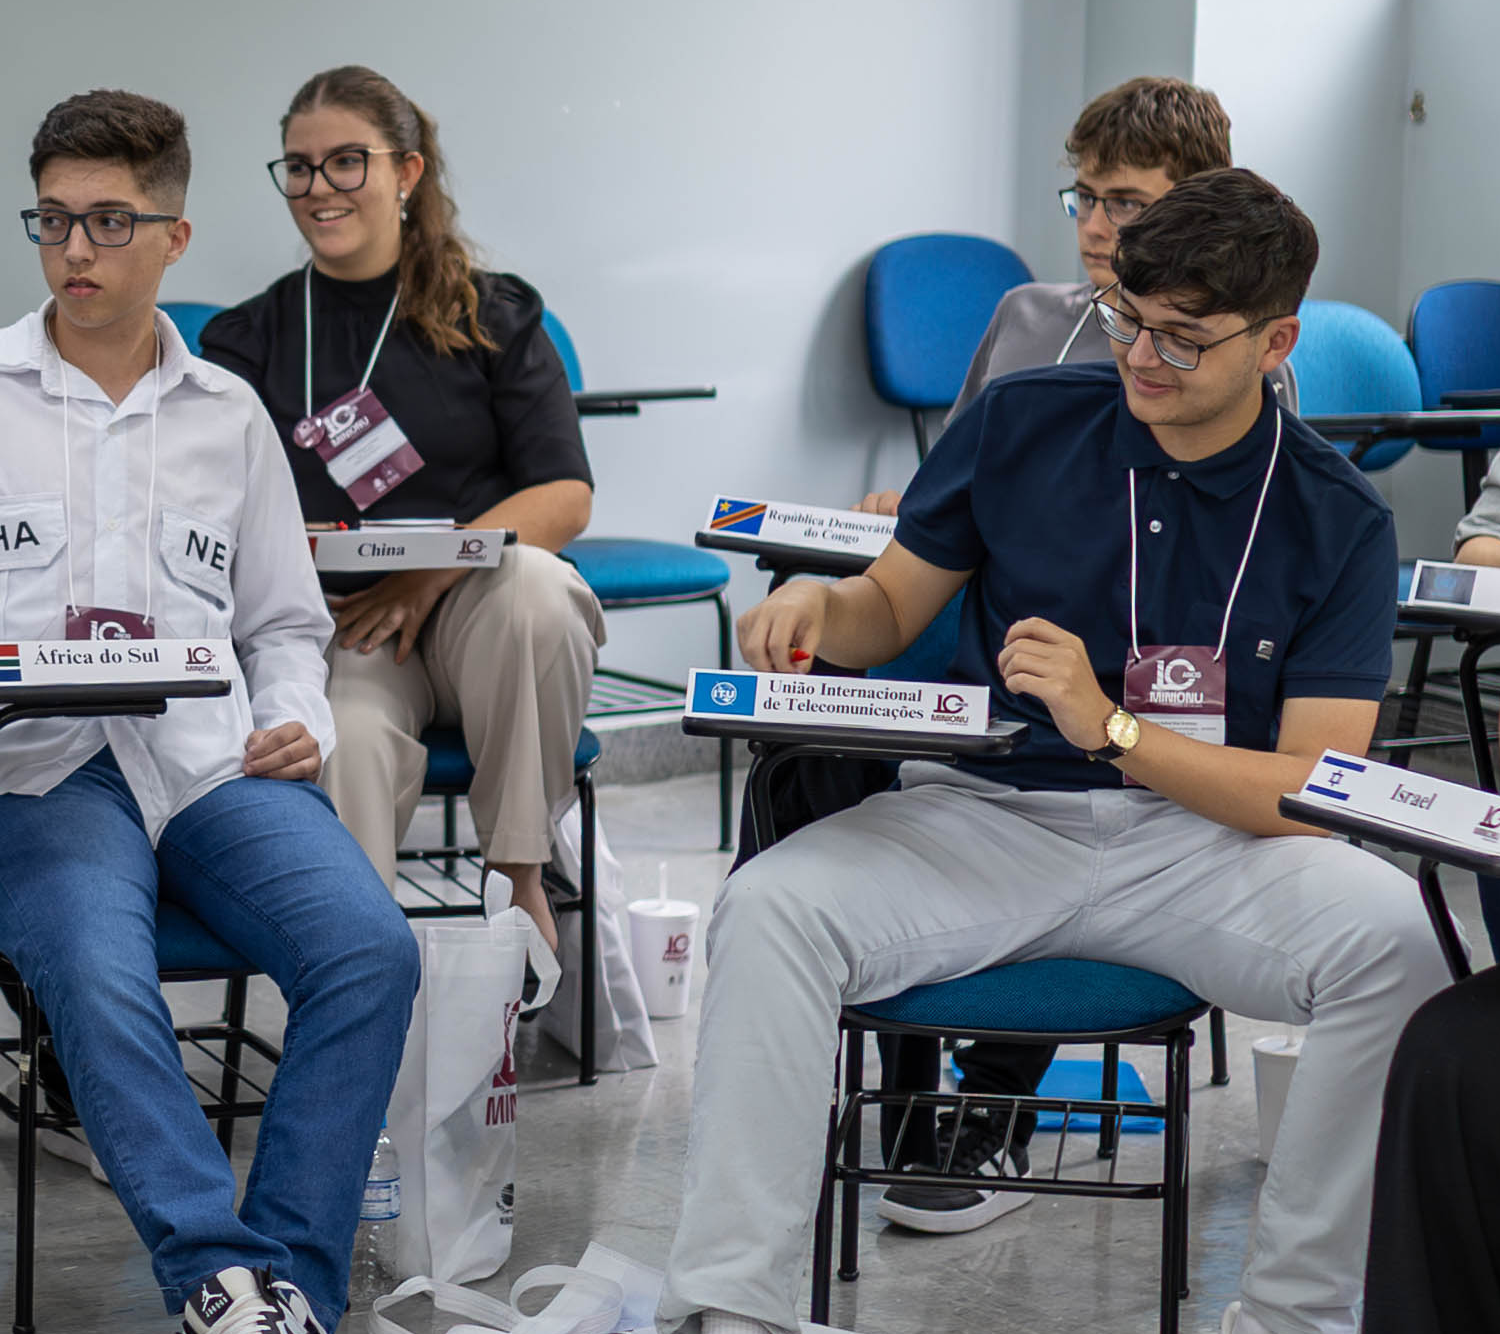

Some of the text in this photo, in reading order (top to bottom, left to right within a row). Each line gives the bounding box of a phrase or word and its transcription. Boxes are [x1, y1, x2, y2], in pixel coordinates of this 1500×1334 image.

[769, 509, 825, 527] República
[804, 527, 860, 544] do Congo
[186, 529, 228, 572] NE
[357, 542, 406, 558] China
[34, 645, 159, 666] África do Sul
[769, 679, 922, 702] União Internacional
[1150, 691, 1204, 705] MINIONU
[763, 697, 924, 720] de Telecomunicações
[1390, 783, 1438, 810] Israel
